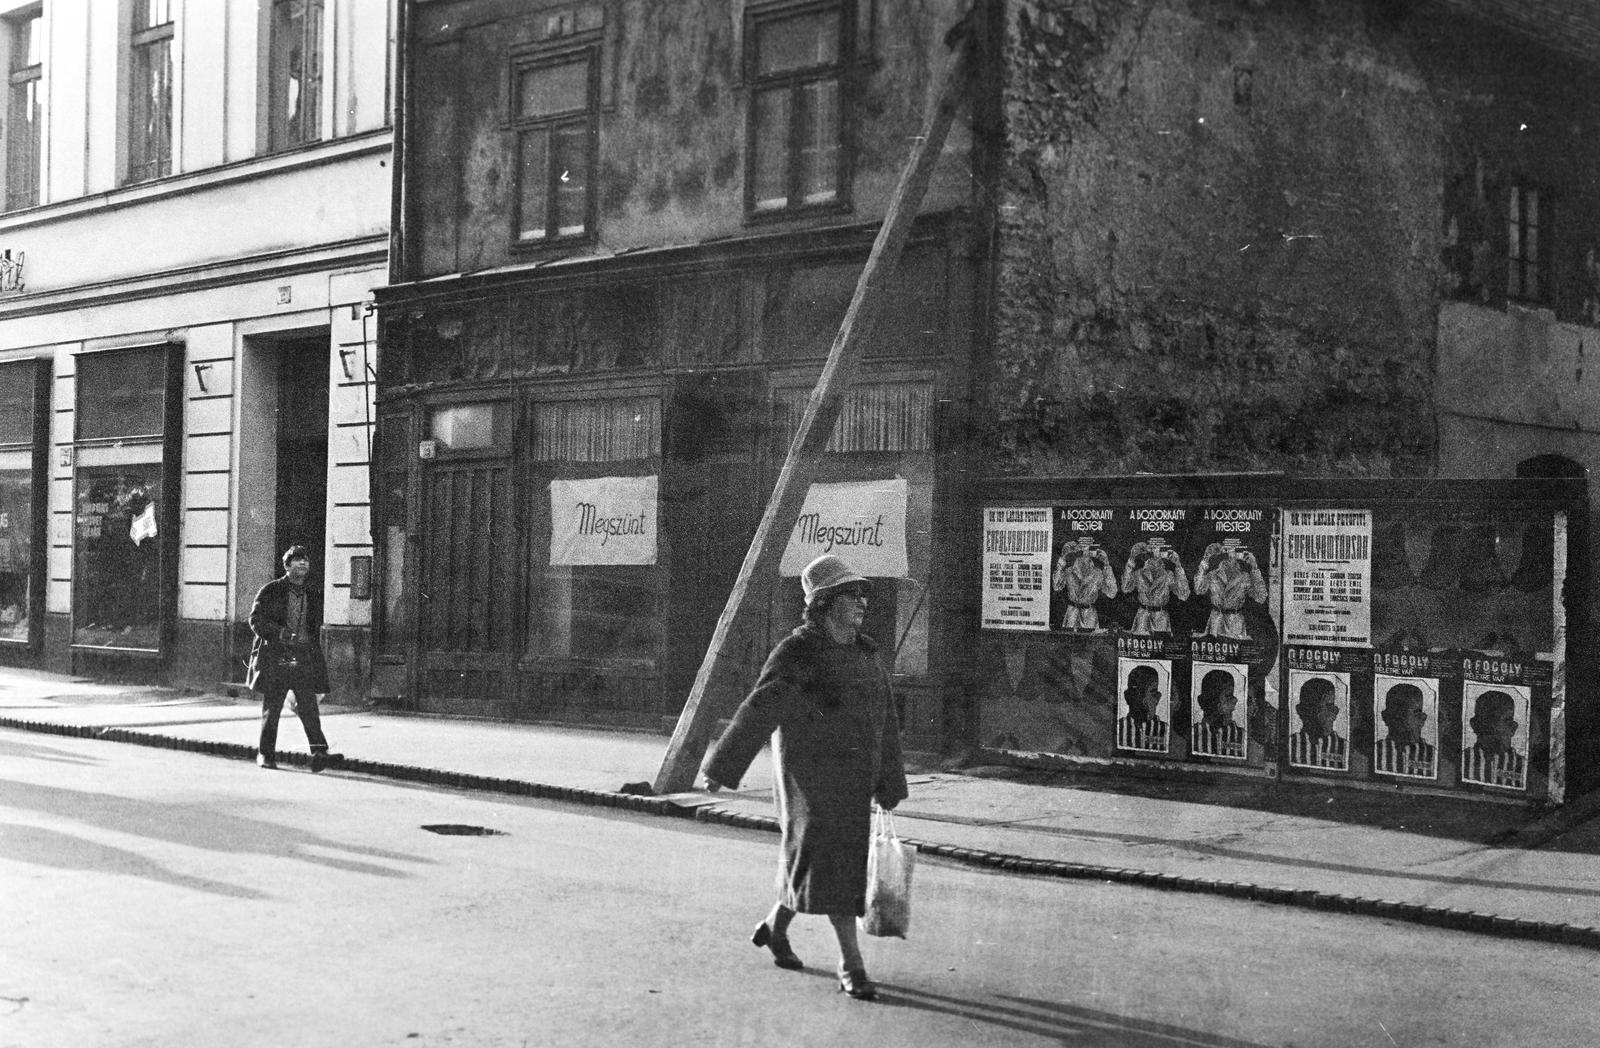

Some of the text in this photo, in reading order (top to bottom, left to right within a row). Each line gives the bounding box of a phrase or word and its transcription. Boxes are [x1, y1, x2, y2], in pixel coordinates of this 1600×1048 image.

[1061, 510, 1066, 520] A
[1129, 510, 1136, 520] A
[1204, 510, 1210, 520] A
[1071, 520, 1103, 531] MESTER
[1141, 520, 1175, 531] MESTER
[1215, 521, 1251, 532] MESTER
[1127, 638, 1163, 650] FOGOLY
[1201, 642, 1239, 654] FOGOLY
[1299, 649, 1341, 662] FOGOLY
[1385, 653, 1428, 667] FOGOLY
[1475, 659, 1521, 674] FOGOLY
